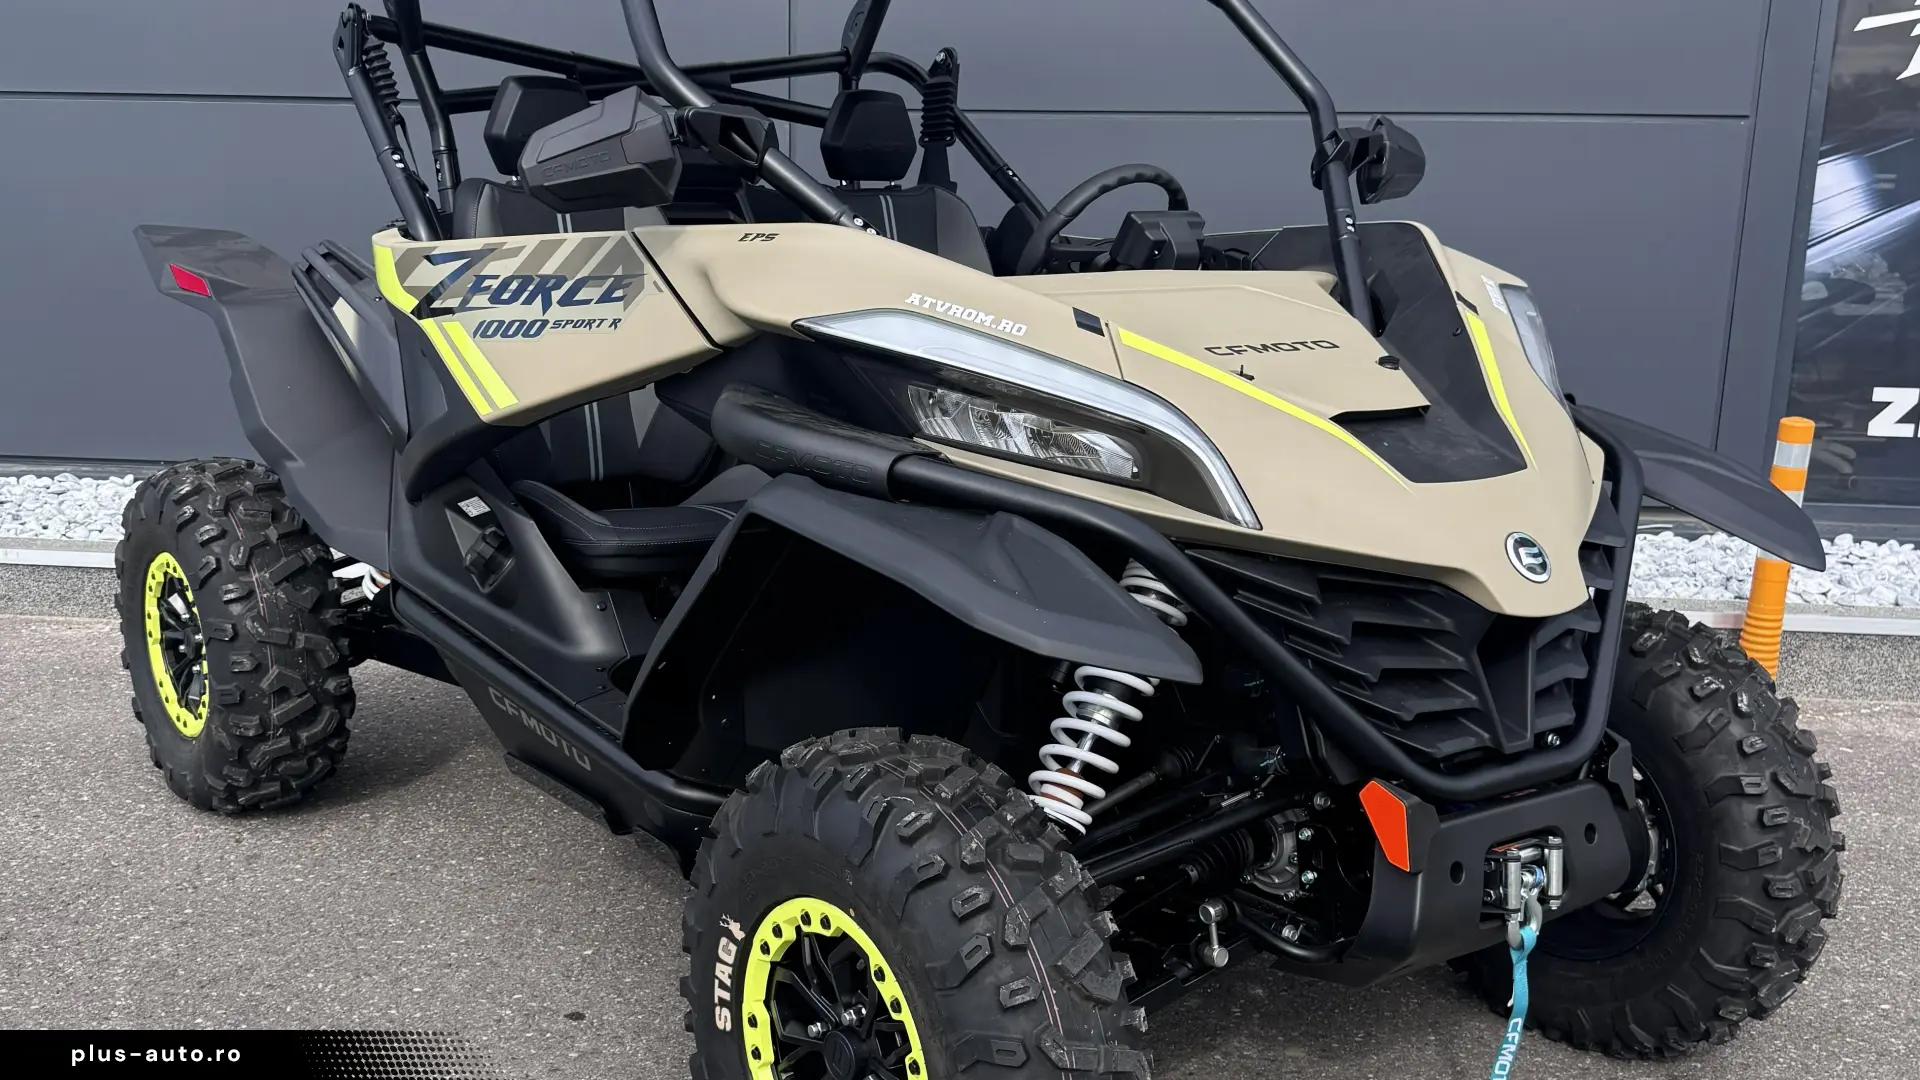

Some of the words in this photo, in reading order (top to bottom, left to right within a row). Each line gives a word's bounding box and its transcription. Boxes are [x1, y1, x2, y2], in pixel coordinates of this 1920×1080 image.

[738, 232, 780, 242] EPS
[904, 292, 1028, 336] ATVROM.RO
[472, 318, 550, 340] 1000
[549, 318, 609, 332] SPORT
[608, 318, 623, 332] R
[1203, 340, 1340, 356] CFMOTO
[714, 936, 738, 1032] STAG
